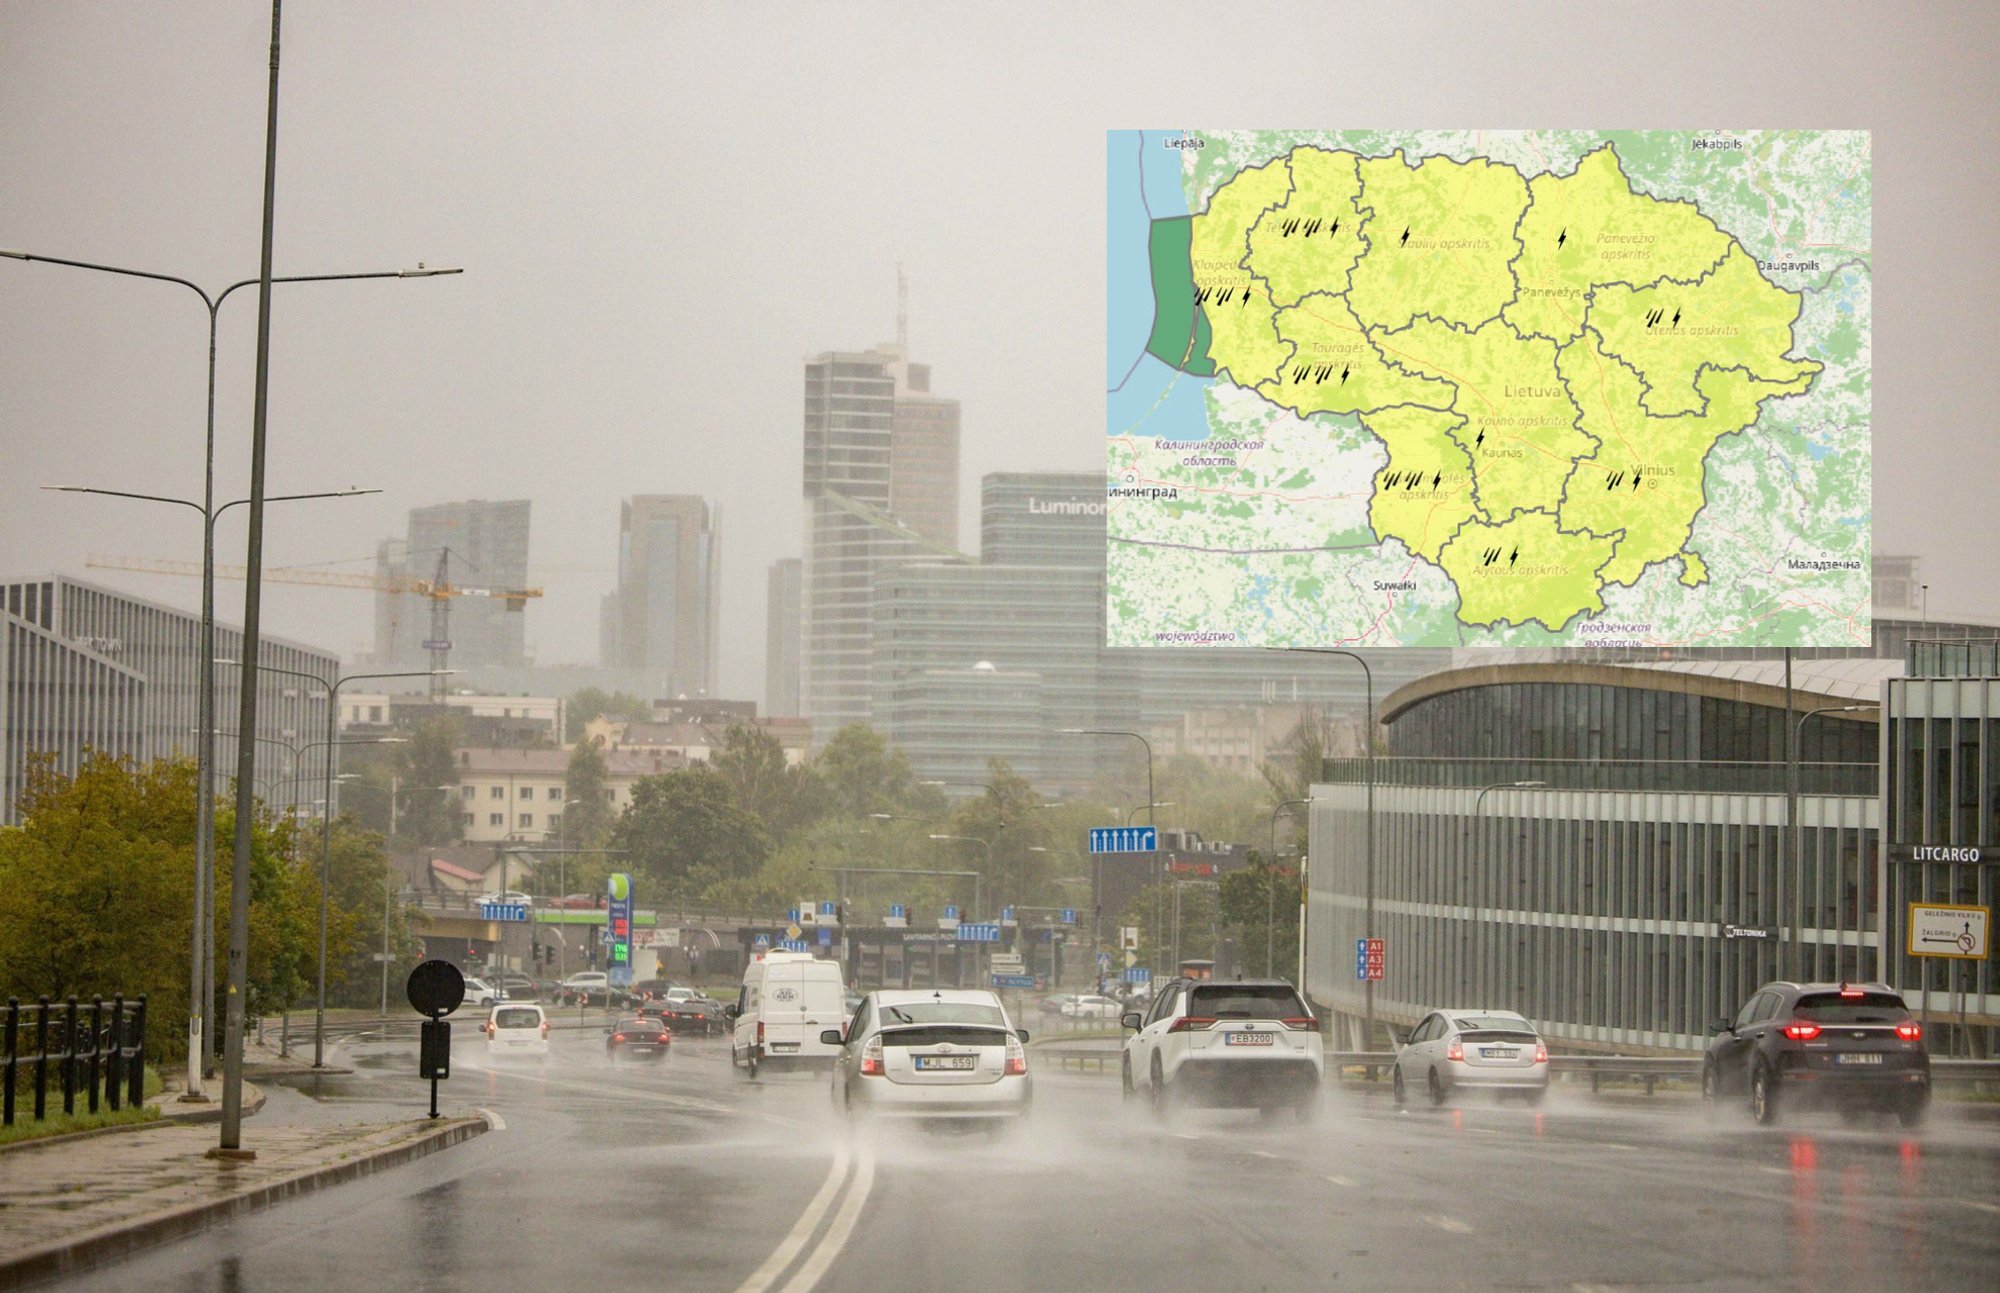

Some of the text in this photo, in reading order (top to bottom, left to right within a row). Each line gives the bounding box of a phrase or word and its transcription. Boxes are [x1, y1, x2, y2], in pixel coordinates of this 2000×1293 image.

[1029, 496, 1107, 516] Luminor
[1913, 846, 1980, 862] LITCARGO
[1733, 928, 1767, 938] TELTONIKA
[1370, 942, 1382, 951] A1
[1369, 955, 1382, 964] A3
[1368, 968, 1382, 977] A4
[1236, 1034, 1271, 1043] EB3200
[923, 1058, 972, 1069] MJL 659
